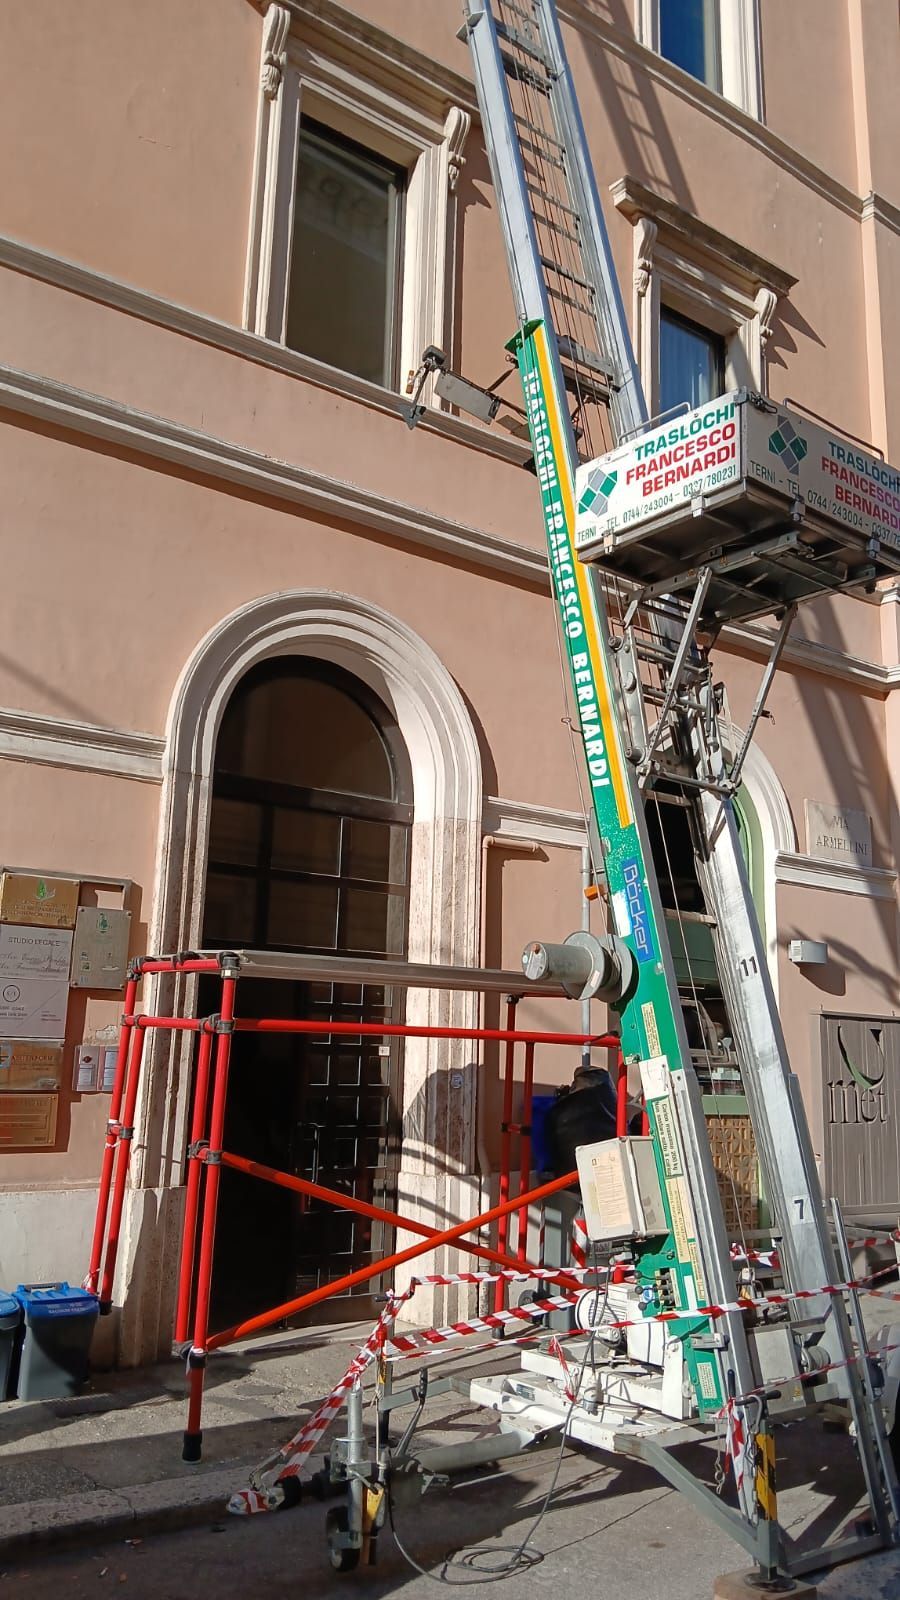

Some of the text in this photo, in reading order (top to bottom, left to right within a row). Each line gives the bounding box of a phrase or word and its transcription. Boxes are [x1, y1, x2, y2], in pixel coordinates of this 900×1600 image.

[625, 422, 736, 485] FRANCESCO
[634, 402, 735, 461] TRASLOCHI
[642, 442, 736, 497] BERNARDI
[750, 459, 776, 484] TERNI
[821, 456, 900, 513] FRANCESCO
[577, 526, 597, 543] TERNI
[523, 366, 611, 788] TRASLOCHI FRANCESCO BERNARDI
[623, 863, 649, 955] Böcker
[740, 955, 758, 977] 11
[827, 1079, 887, 1124] met
[793, 1198, 804, 1220] 7
